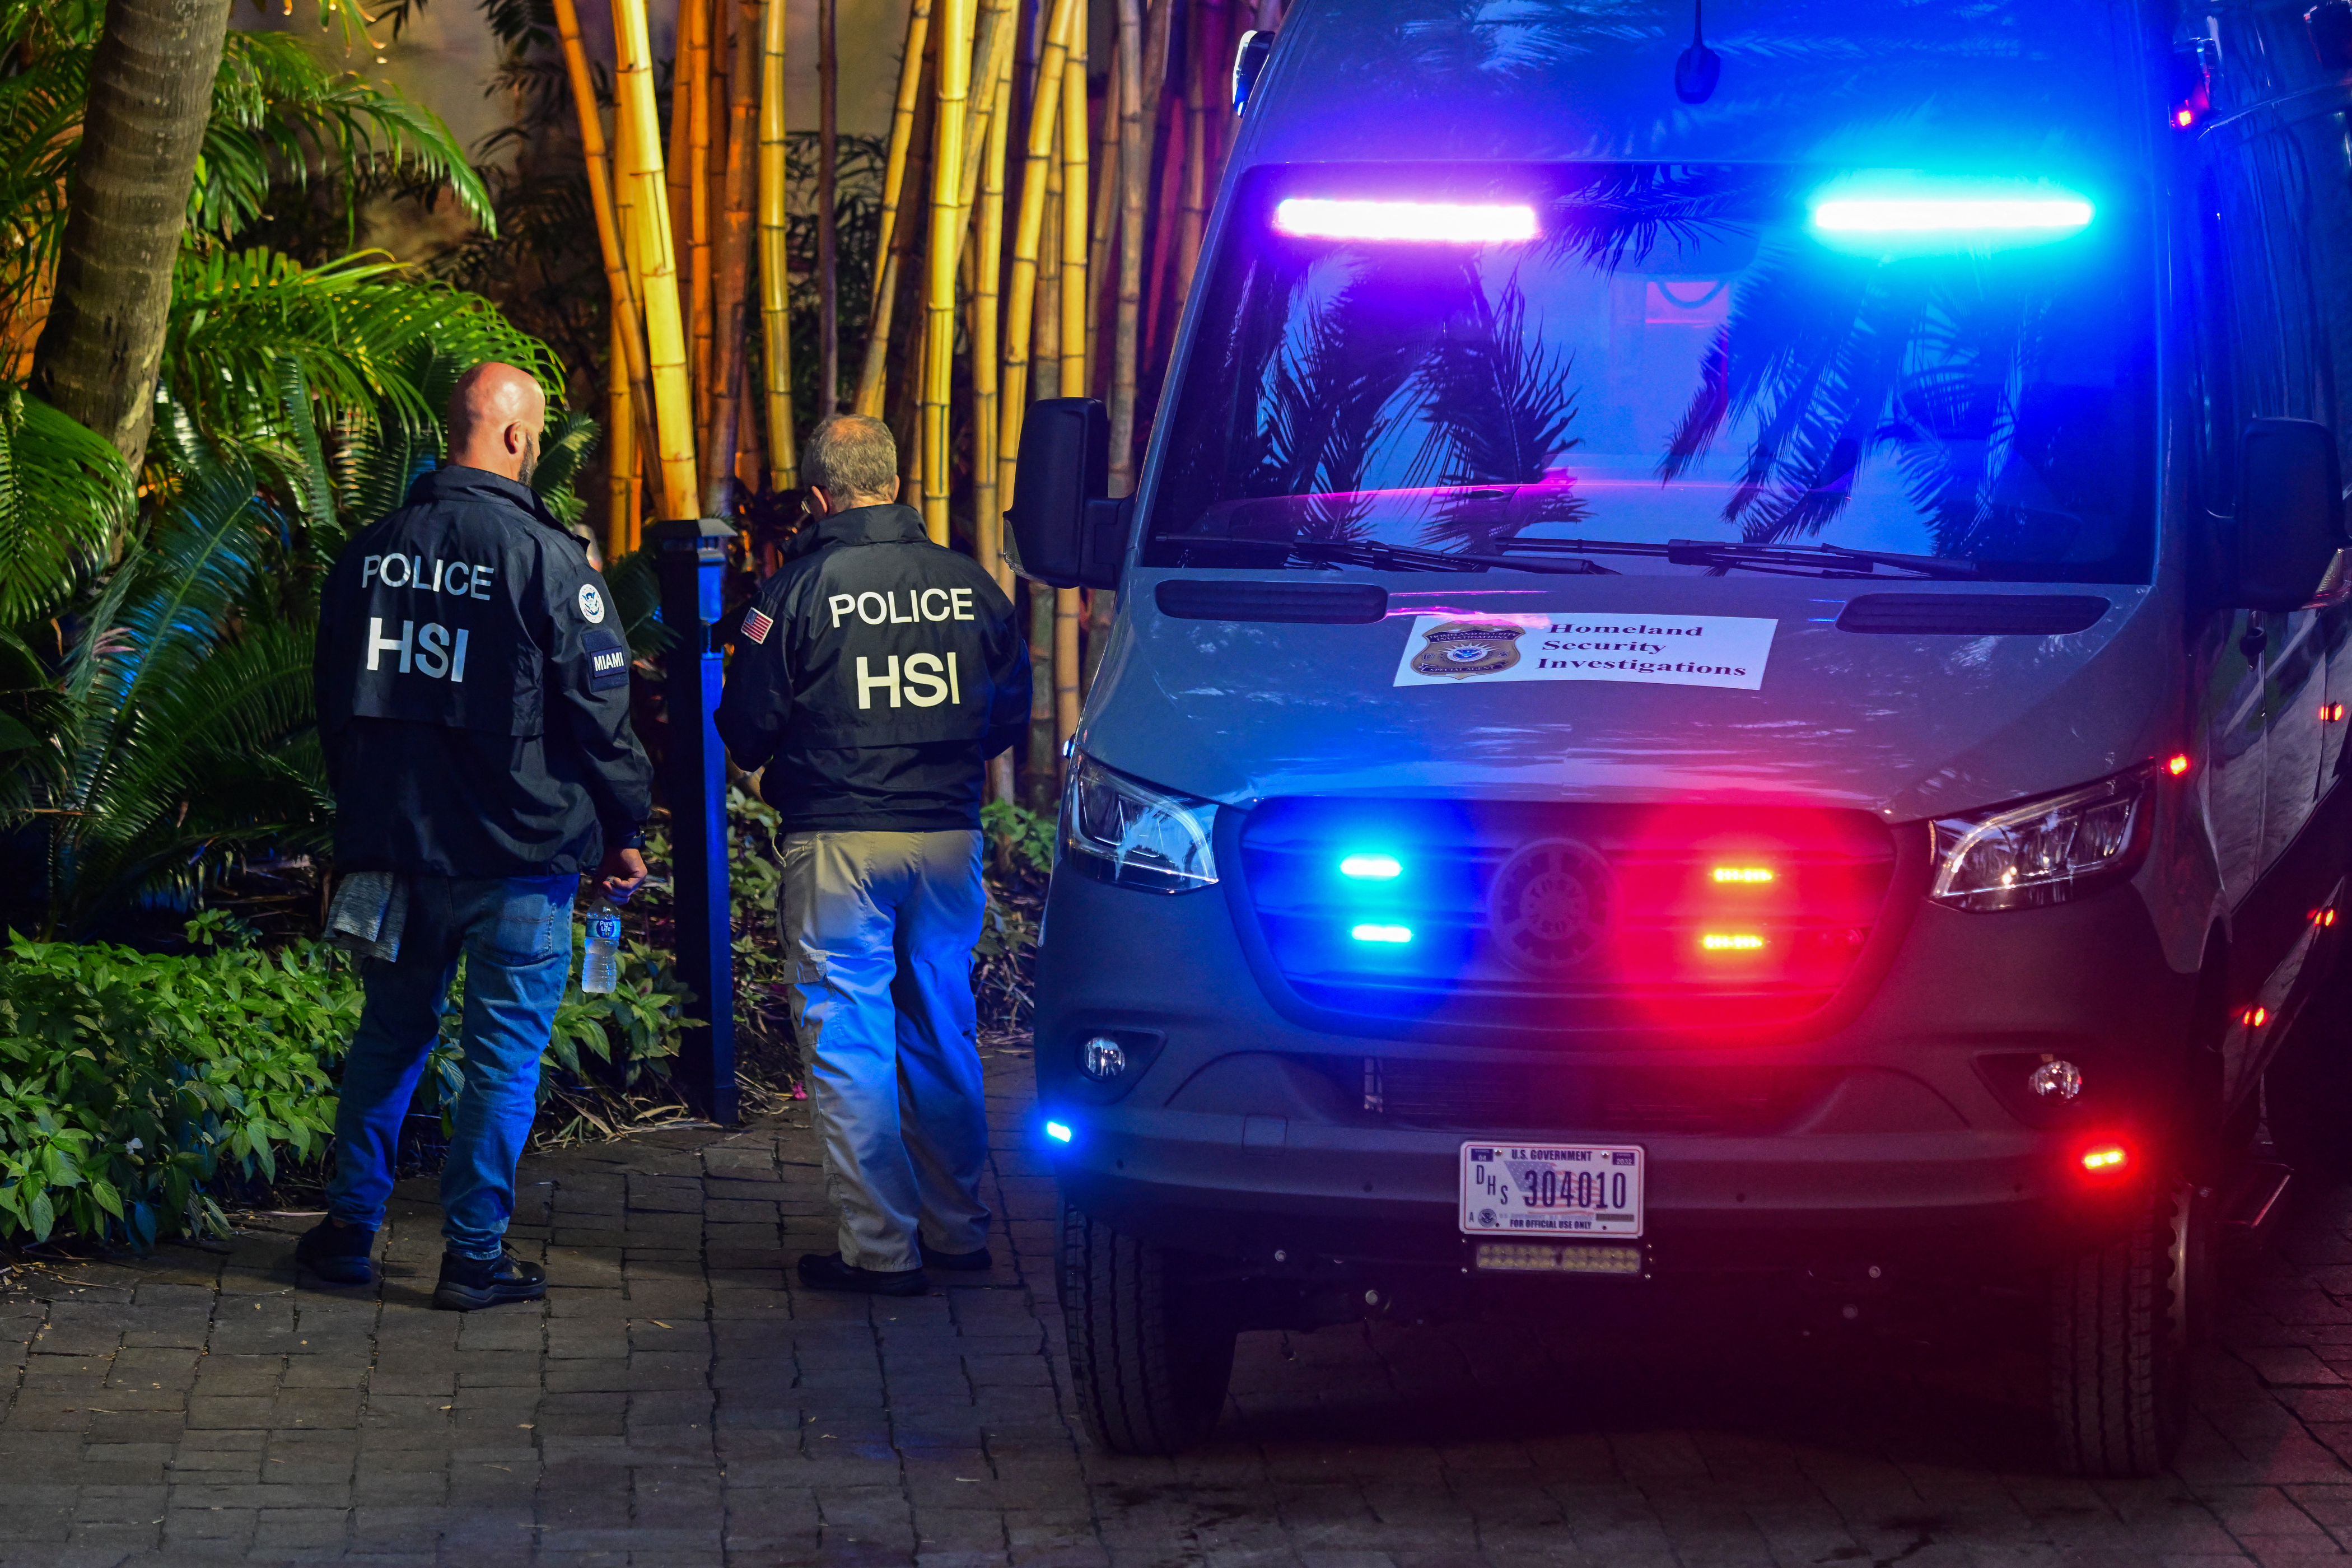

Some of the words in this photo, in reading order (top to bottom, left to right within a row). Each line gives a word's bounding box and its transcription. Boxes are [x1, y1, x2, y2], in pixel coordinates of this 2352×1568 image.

[362, 552, 494, 601] POLICE
[828, 588, 974, 628] POLICE
[1547, 623, 1704, 636] Homeland
[367, 617, 469, 683] HSI
[1542, 641, 1667, 655] Security
[594, 652, 624, 671] MIAMI
[1536, 657, 1746, 676] Investigations
[856, 652, 960, 710] HSI
[1511, 1149, 1528, 1160] U.S.
[1530, 1150, 1593, 1161] GOVERNMENT
[1524, 1170, 1626, 1210] 304010
[1468, 1211, 1474, 1222] A
[1510, 1219, 1524, 1228] FOR
[1525, 1219, 1557, 1229] OFFICIAL
[1558, 1220, 1572, 1229] USE
[1574, 1221, 1592, 1229] ONLY
